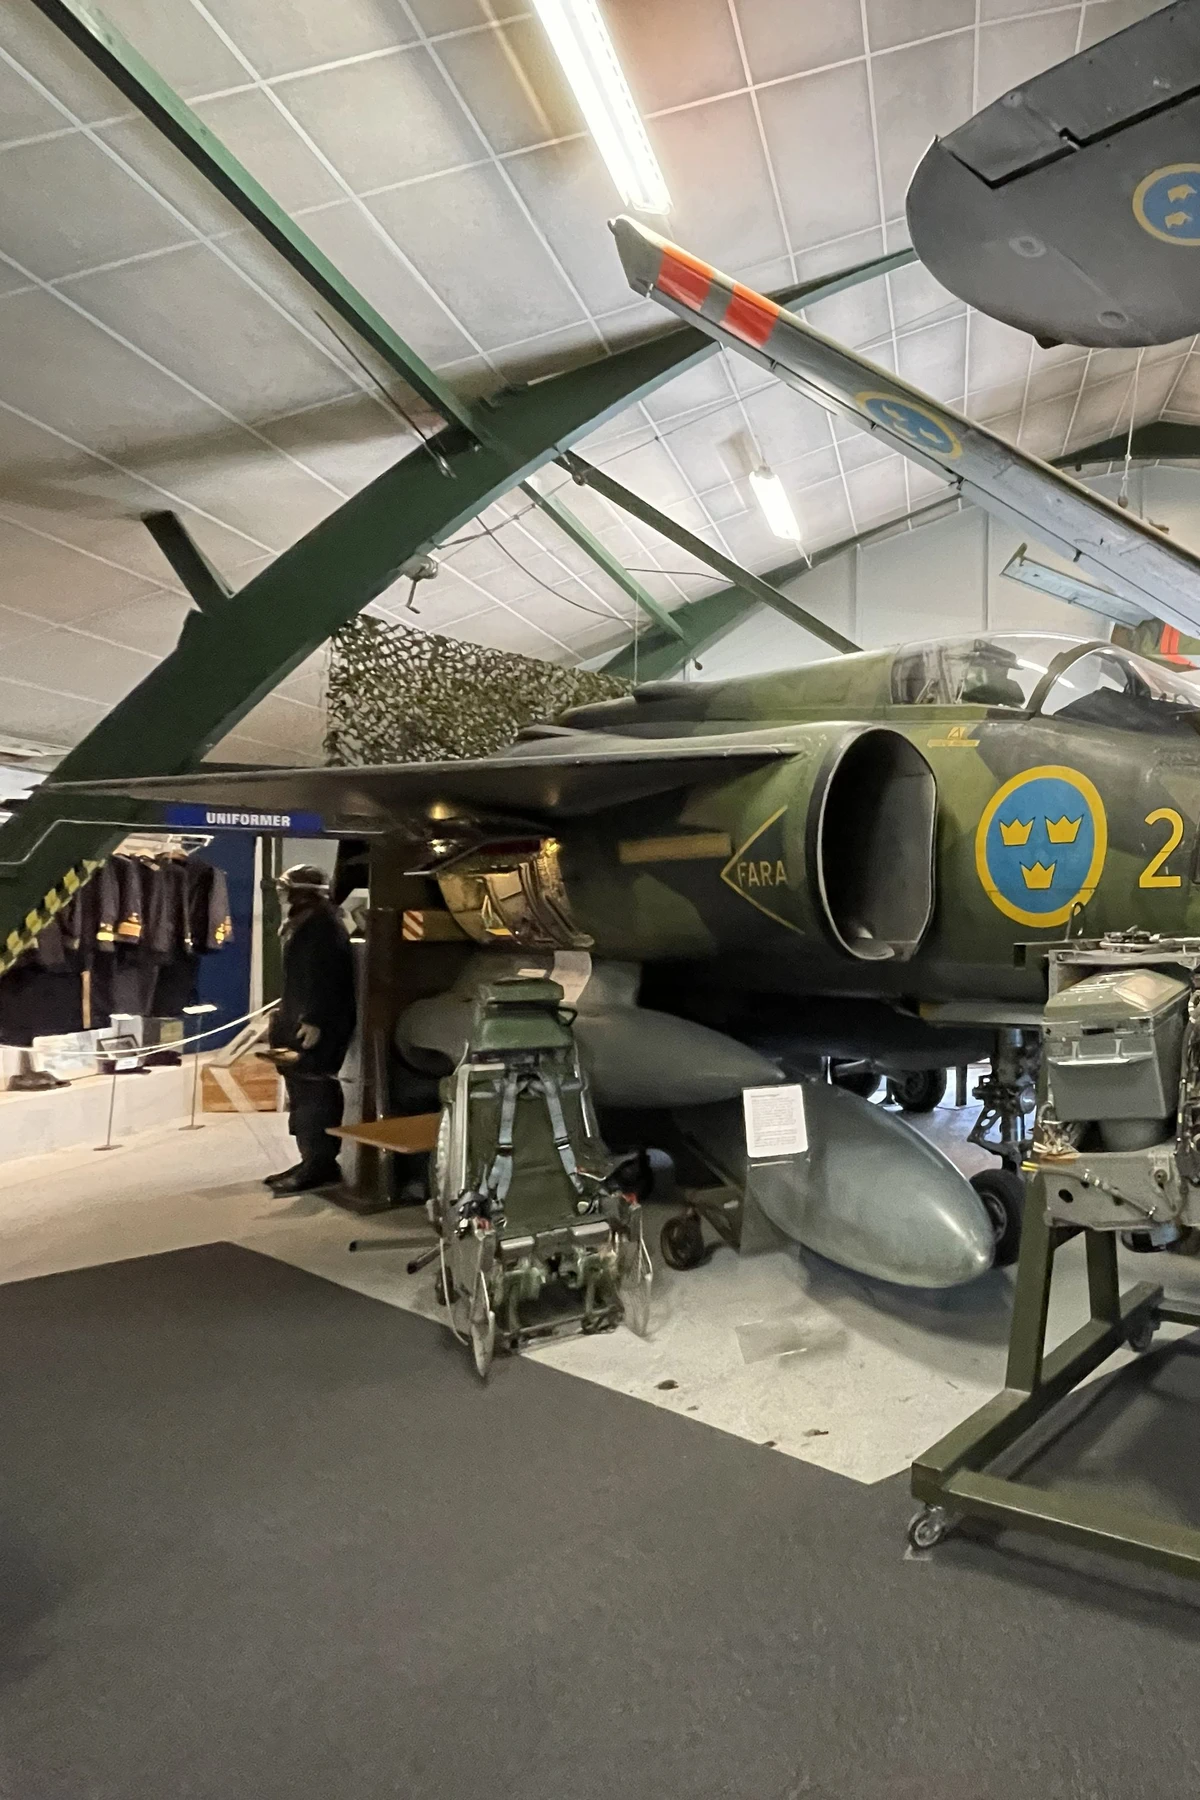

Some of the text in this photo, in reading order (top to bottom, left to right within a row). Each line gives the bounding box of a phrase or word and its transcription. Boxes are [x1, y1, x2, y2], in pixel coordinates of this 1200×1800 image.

[206, 812, 291, 827] UNIFORMER
[1139, 807, 1184, 888] 2
[737, 860, 788, 887] FARA
